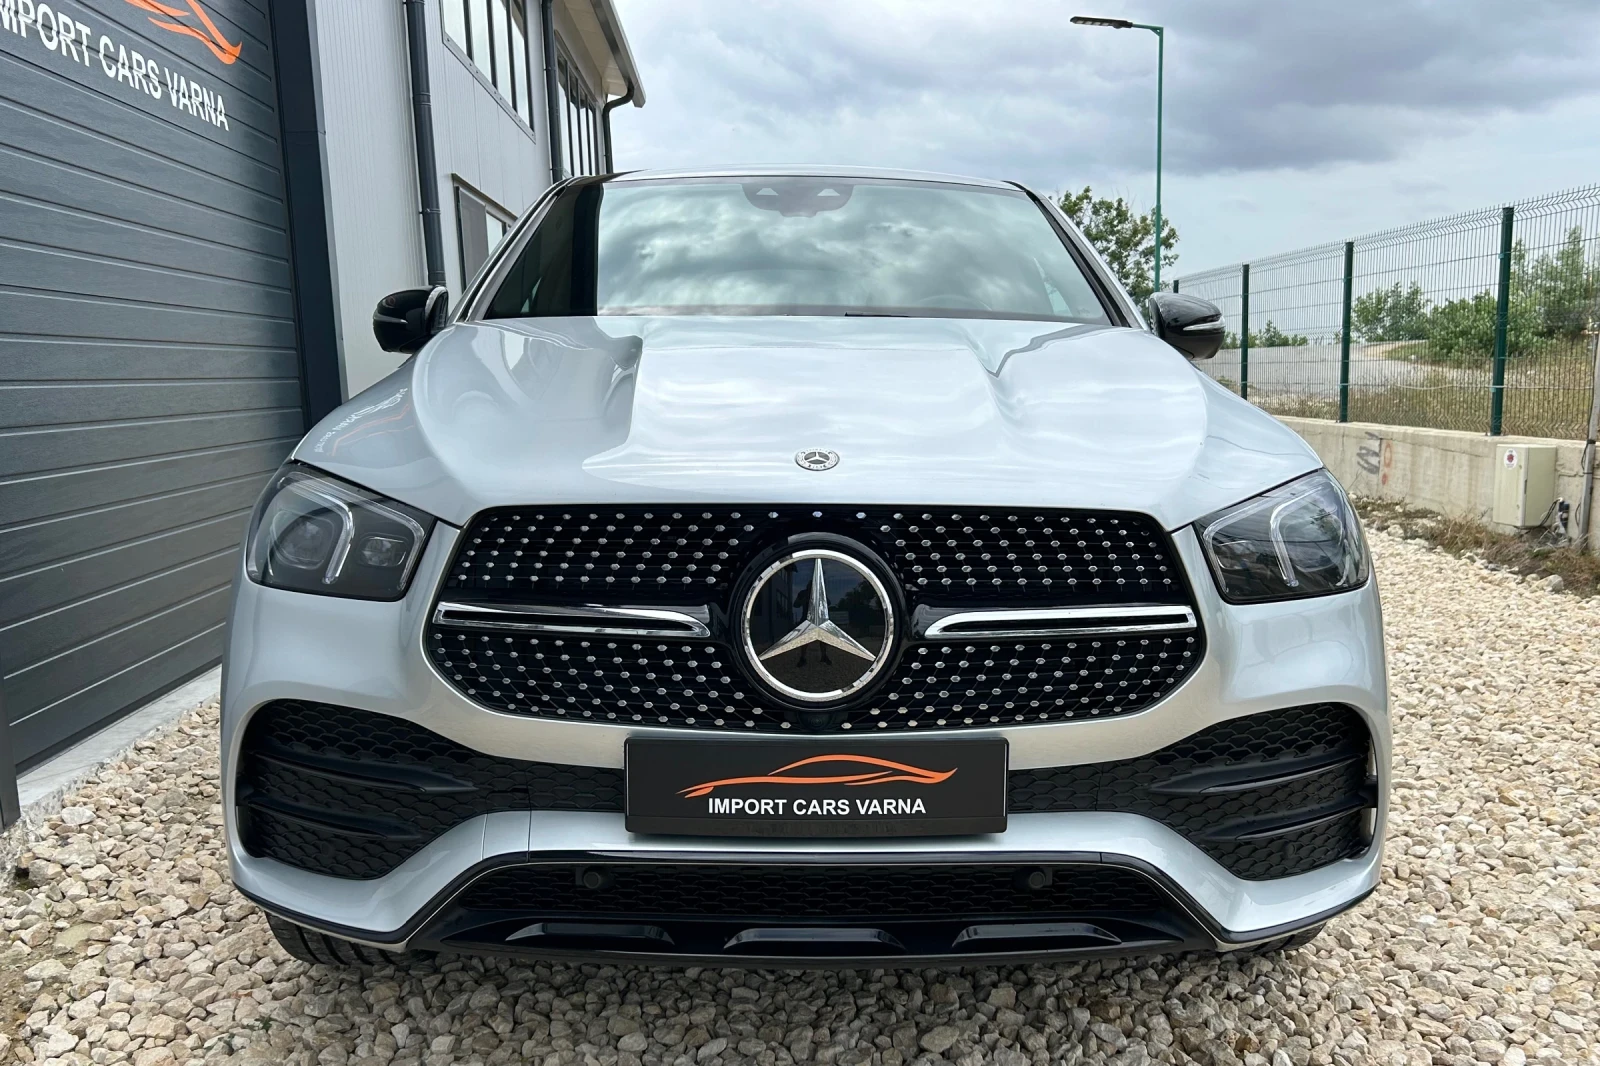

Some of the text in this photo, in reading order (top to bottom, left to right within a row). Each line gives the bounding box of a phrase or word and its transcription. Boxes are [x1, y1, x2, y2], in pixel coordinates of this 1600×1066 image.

[0, 0, 229, 131] MPORT CARS VARNA
[708, 798, 927, 815] IMPORT CARS VARNA
